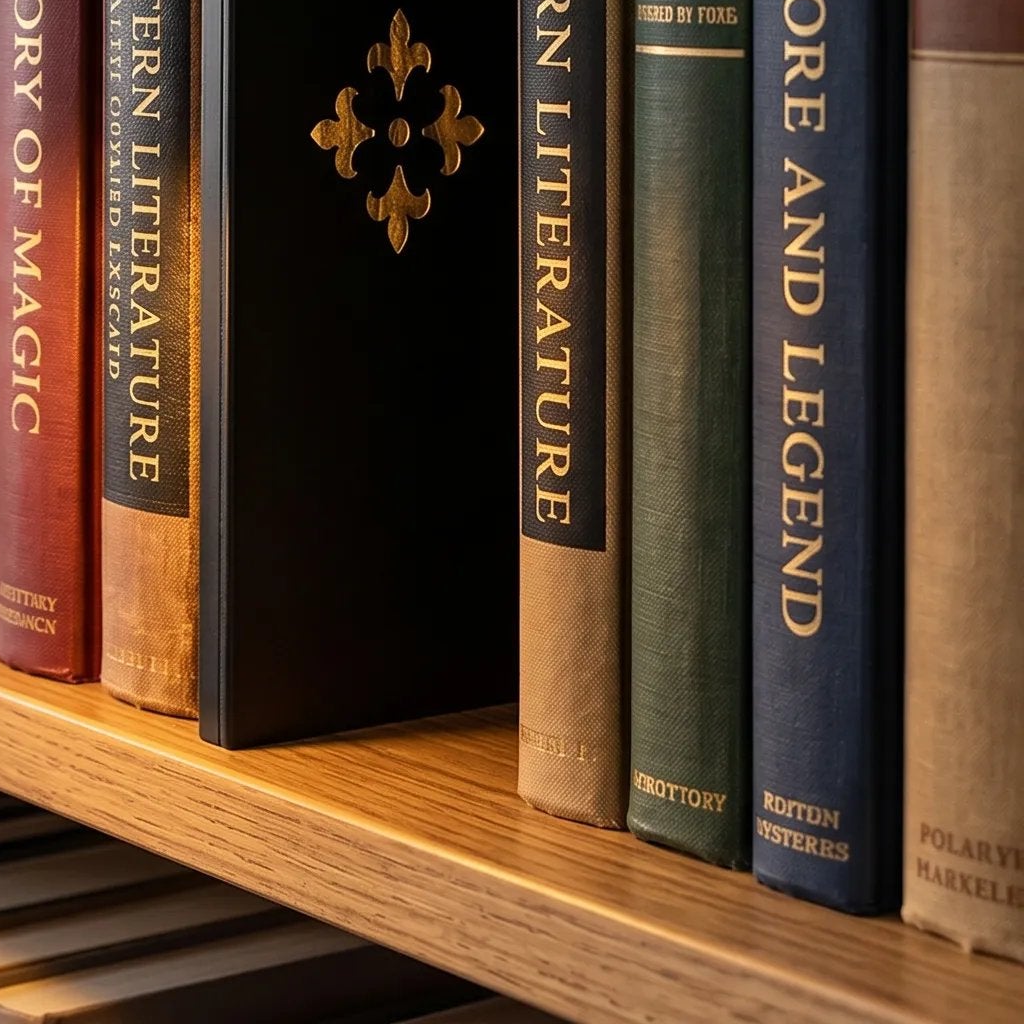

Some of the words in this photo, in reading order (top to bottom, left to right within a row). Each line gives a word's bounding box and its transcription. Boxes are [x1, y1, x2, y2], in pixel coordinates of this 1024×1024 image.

[677, 6, 693, 24] BY
[12, 128, 43, 209] OF
[783, 157, 826, 316] AND
[11, 227, 43, 435] MAGIC
[129, 142, 162, 483] LITERATURE
[535, 98, 572, 525] LITERATURE
[781, 339, 825, 638] LEGEND
